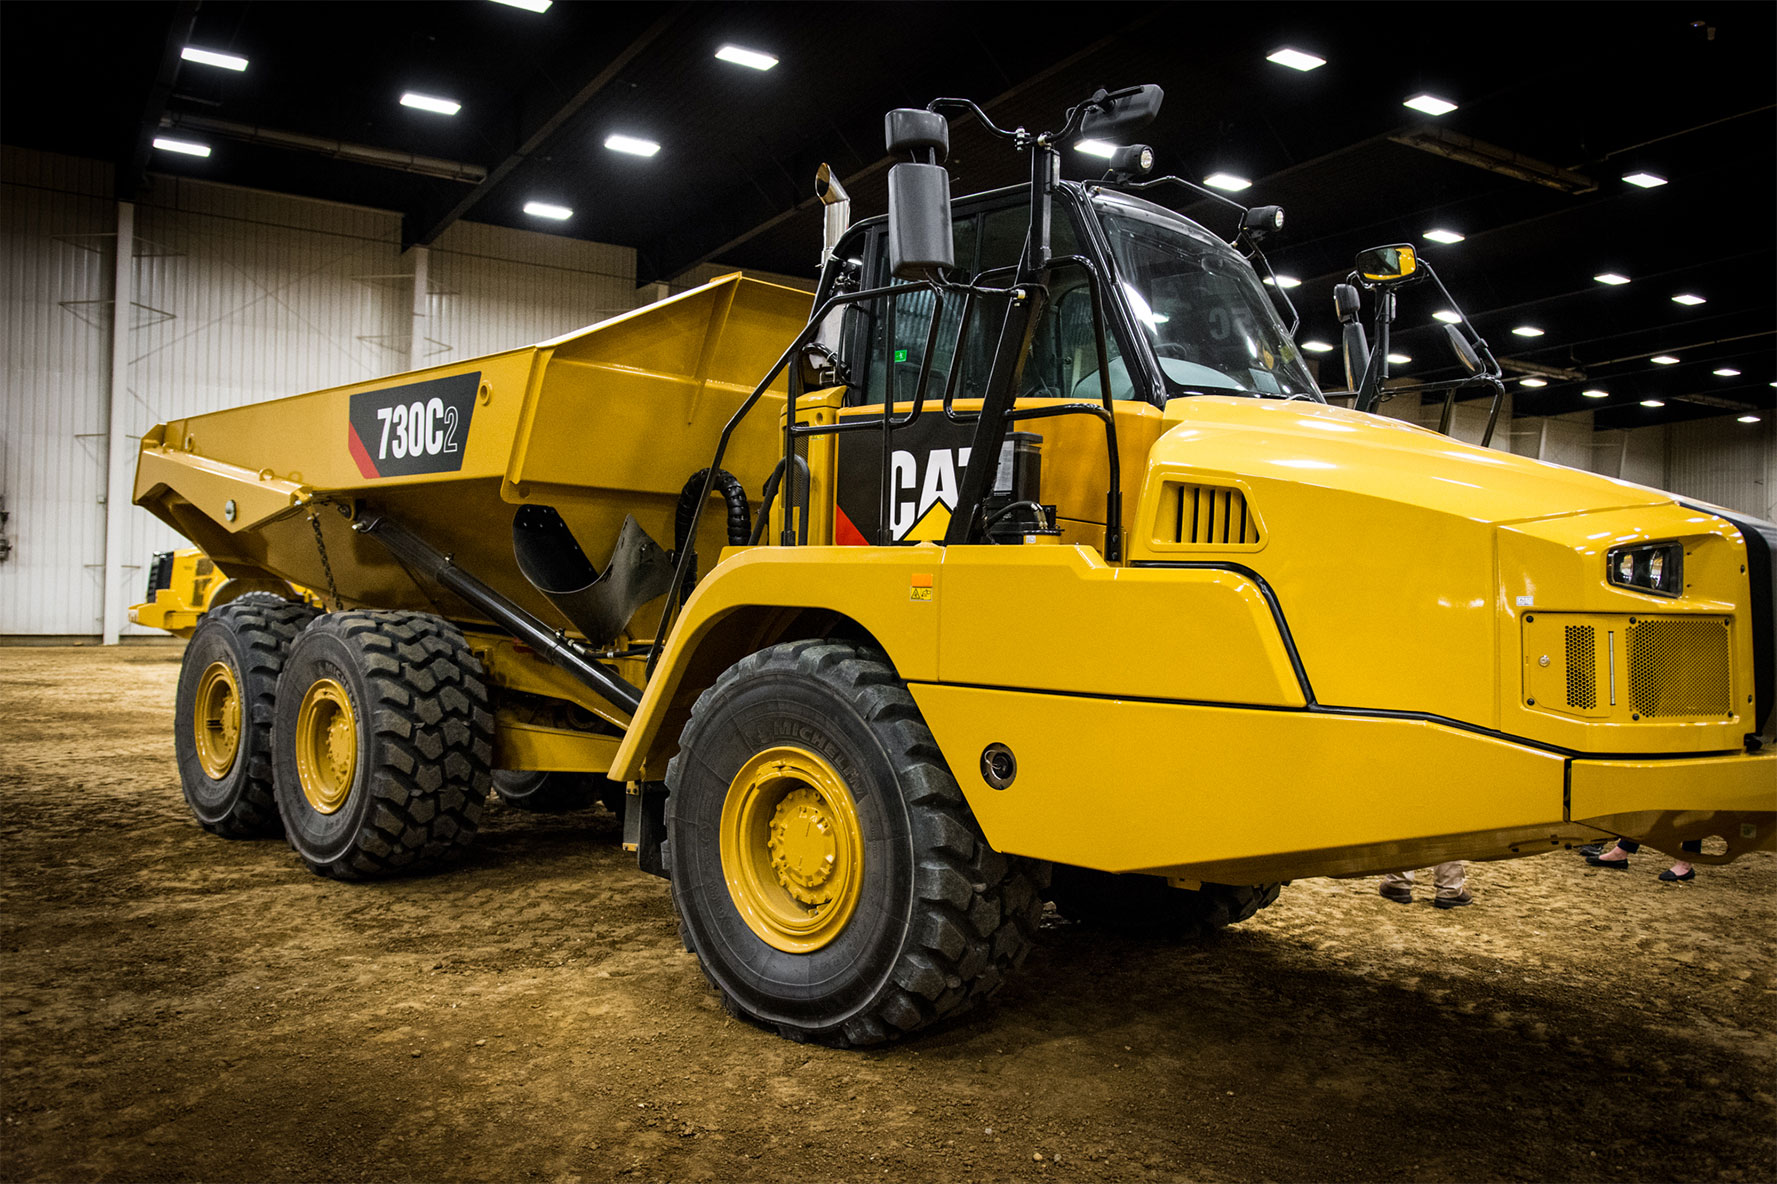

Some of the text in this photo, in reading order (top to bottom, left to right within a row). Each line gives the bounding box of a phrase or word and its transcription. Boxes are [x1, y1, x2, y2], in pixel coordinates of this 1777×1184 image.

[377, 397, 459, 460] 730C2
[890, 447, 973, 541] CA
[773, 720, 866, 797] MICHELIN
